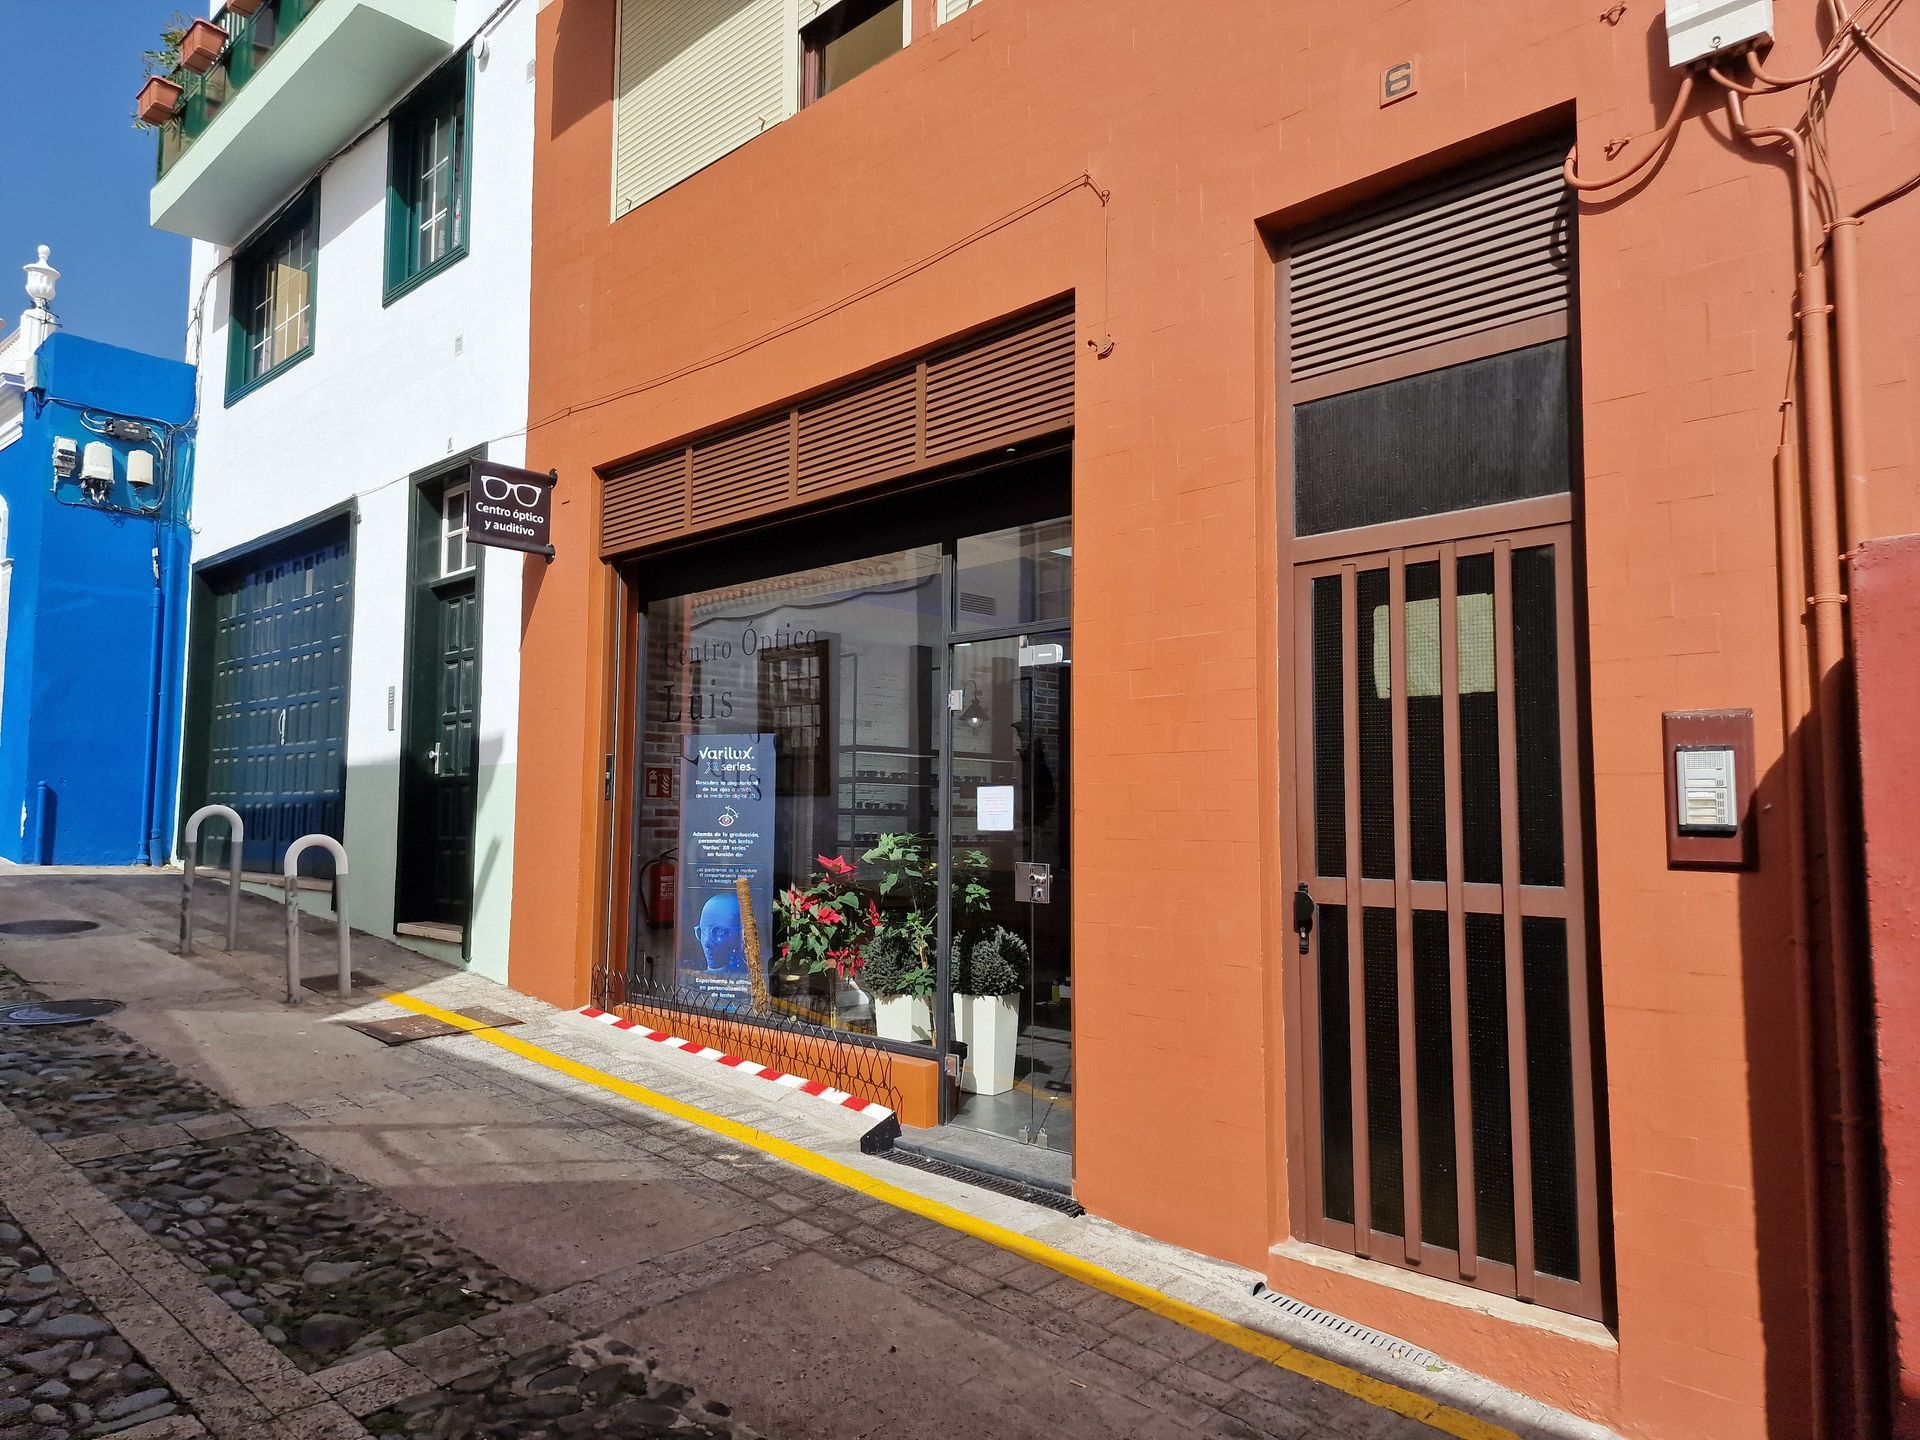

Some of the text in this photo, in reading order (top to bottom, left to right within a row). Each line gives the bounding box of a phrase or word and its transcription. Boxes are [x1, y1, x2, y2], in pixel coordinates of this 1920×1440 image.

[1385, 62, 1411, 98] 6
[475, 502, 544, 524] Centro óptico
[484, 520, 535, 536] y auditivo
[664, 620, 818, 668] Centro Óptico
[662, 679, 733, 722] Luis
